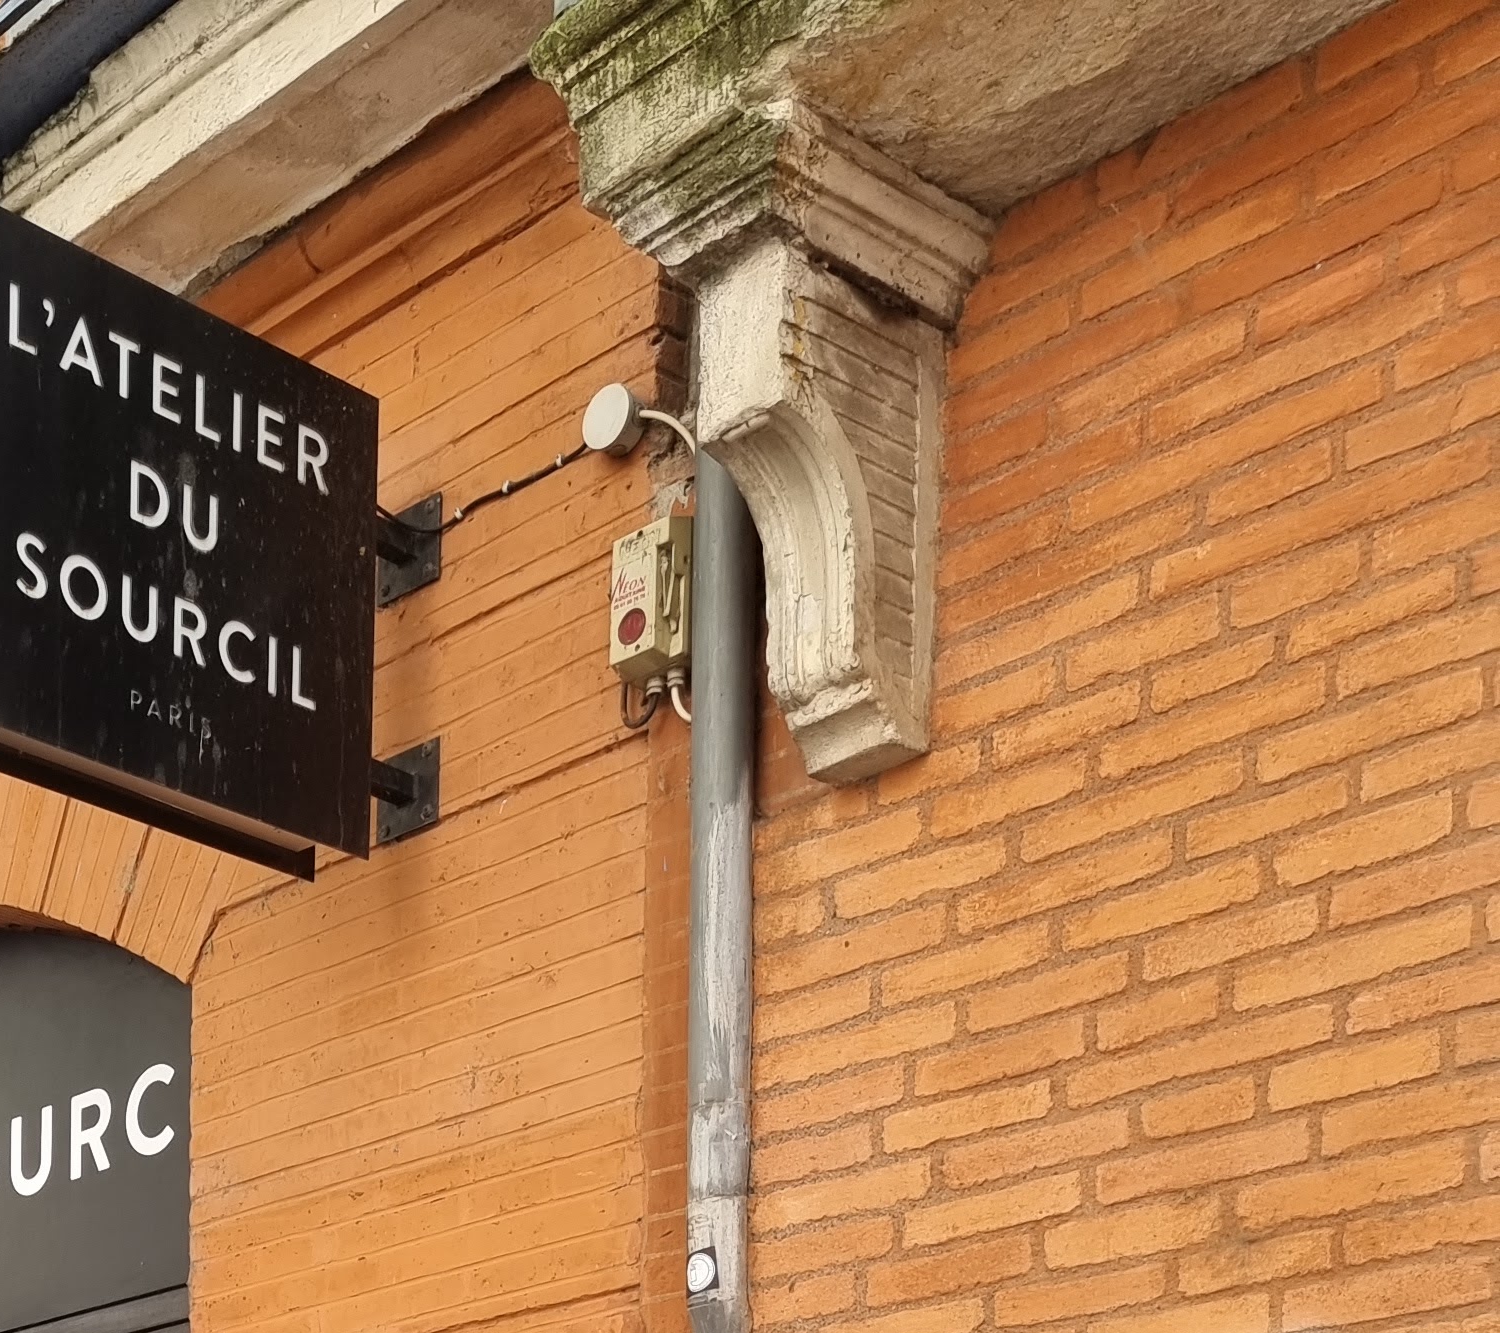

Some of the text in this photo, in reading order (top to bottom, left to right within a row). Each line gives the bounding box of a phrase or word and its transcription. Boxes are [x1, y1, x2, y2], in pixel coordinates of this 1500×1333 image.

[8, 281, 329, 496] L'ATELIER
[129, 459, 219, 554] DU
[16, 531, 317, 711] SOURCIL
[130, 689, 212, 740] PARIS
